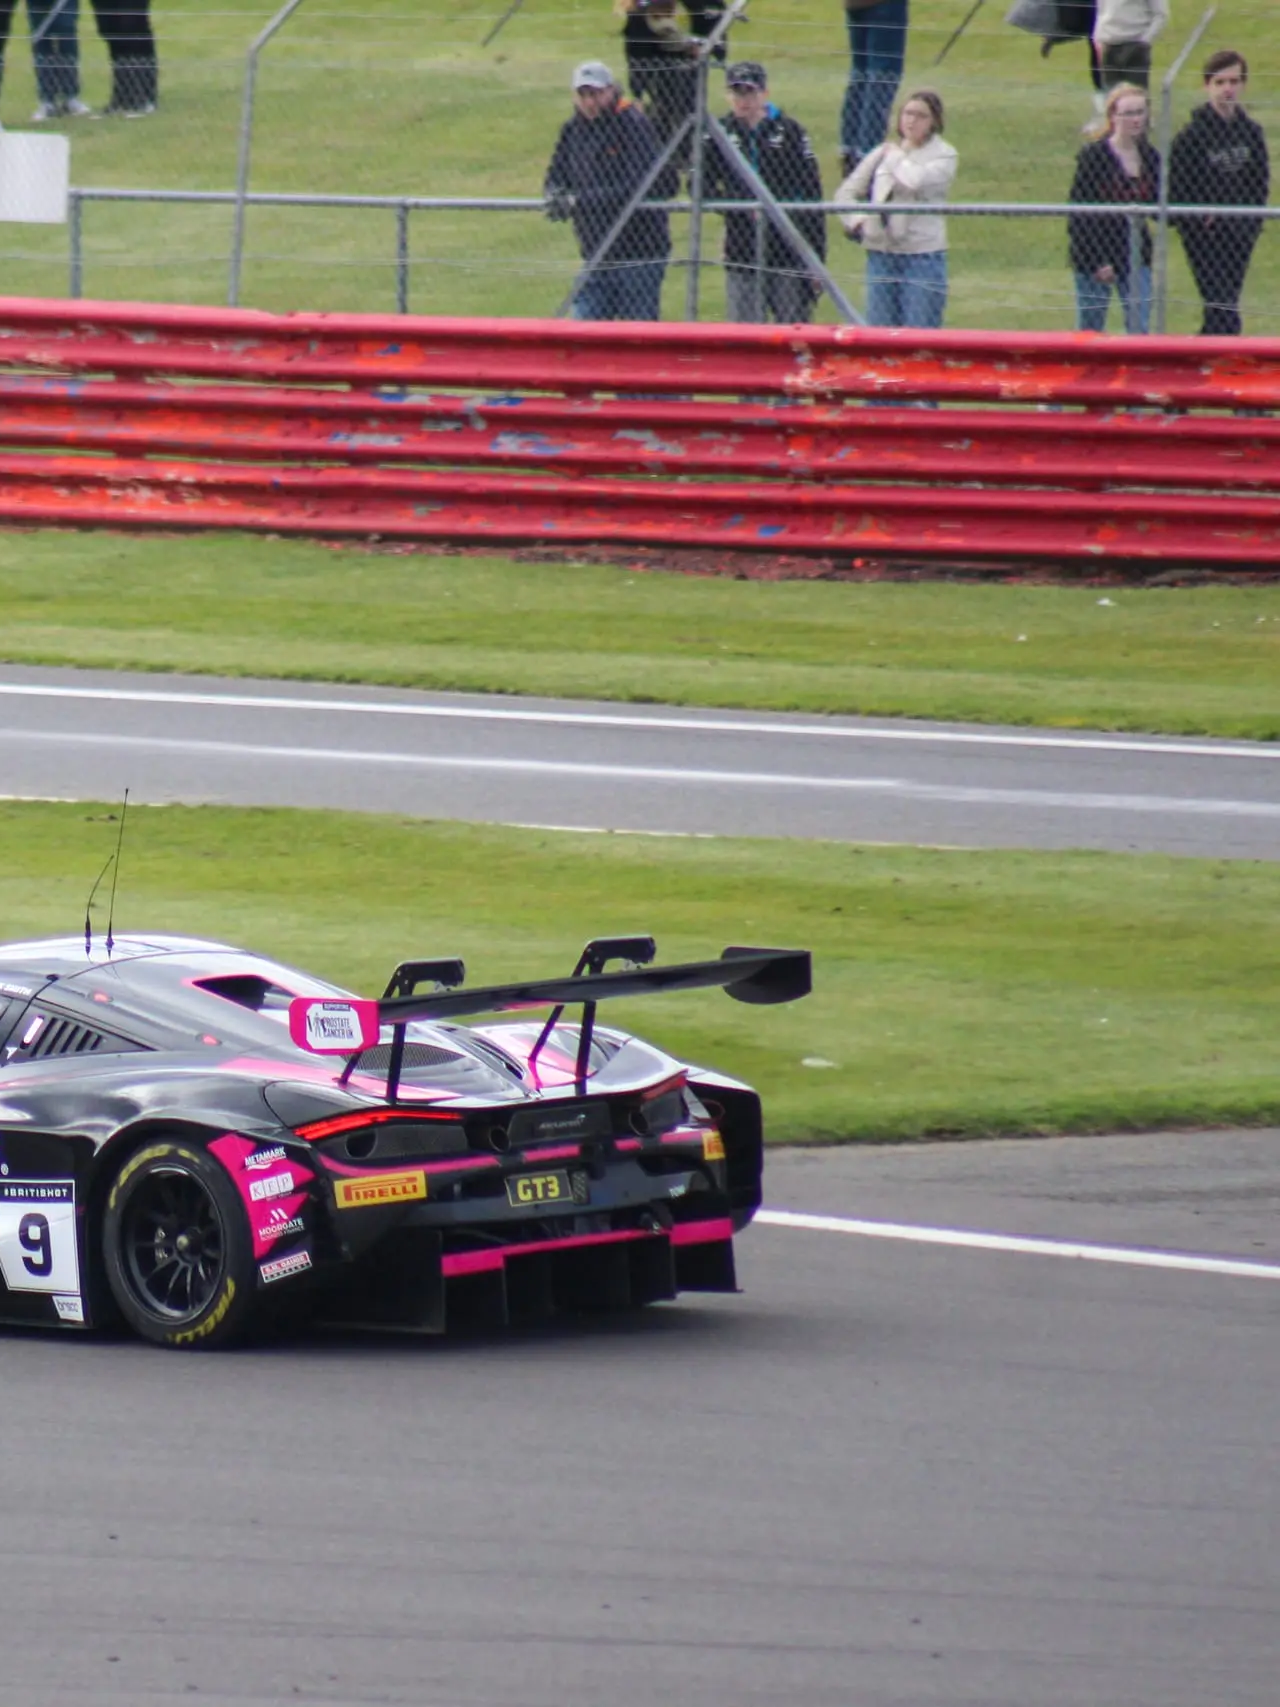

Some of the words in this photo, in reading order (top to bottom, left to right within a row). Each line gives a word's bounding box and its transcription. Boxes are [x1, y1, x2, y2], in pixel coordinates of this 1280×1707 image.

[245, 1146, 286, 1166] METAMARK
[343, 1177, 418, 1202] PIRELLI
[517, 1175, 560, 1201] GT3
[18, 1212, 53, 1277] 9
